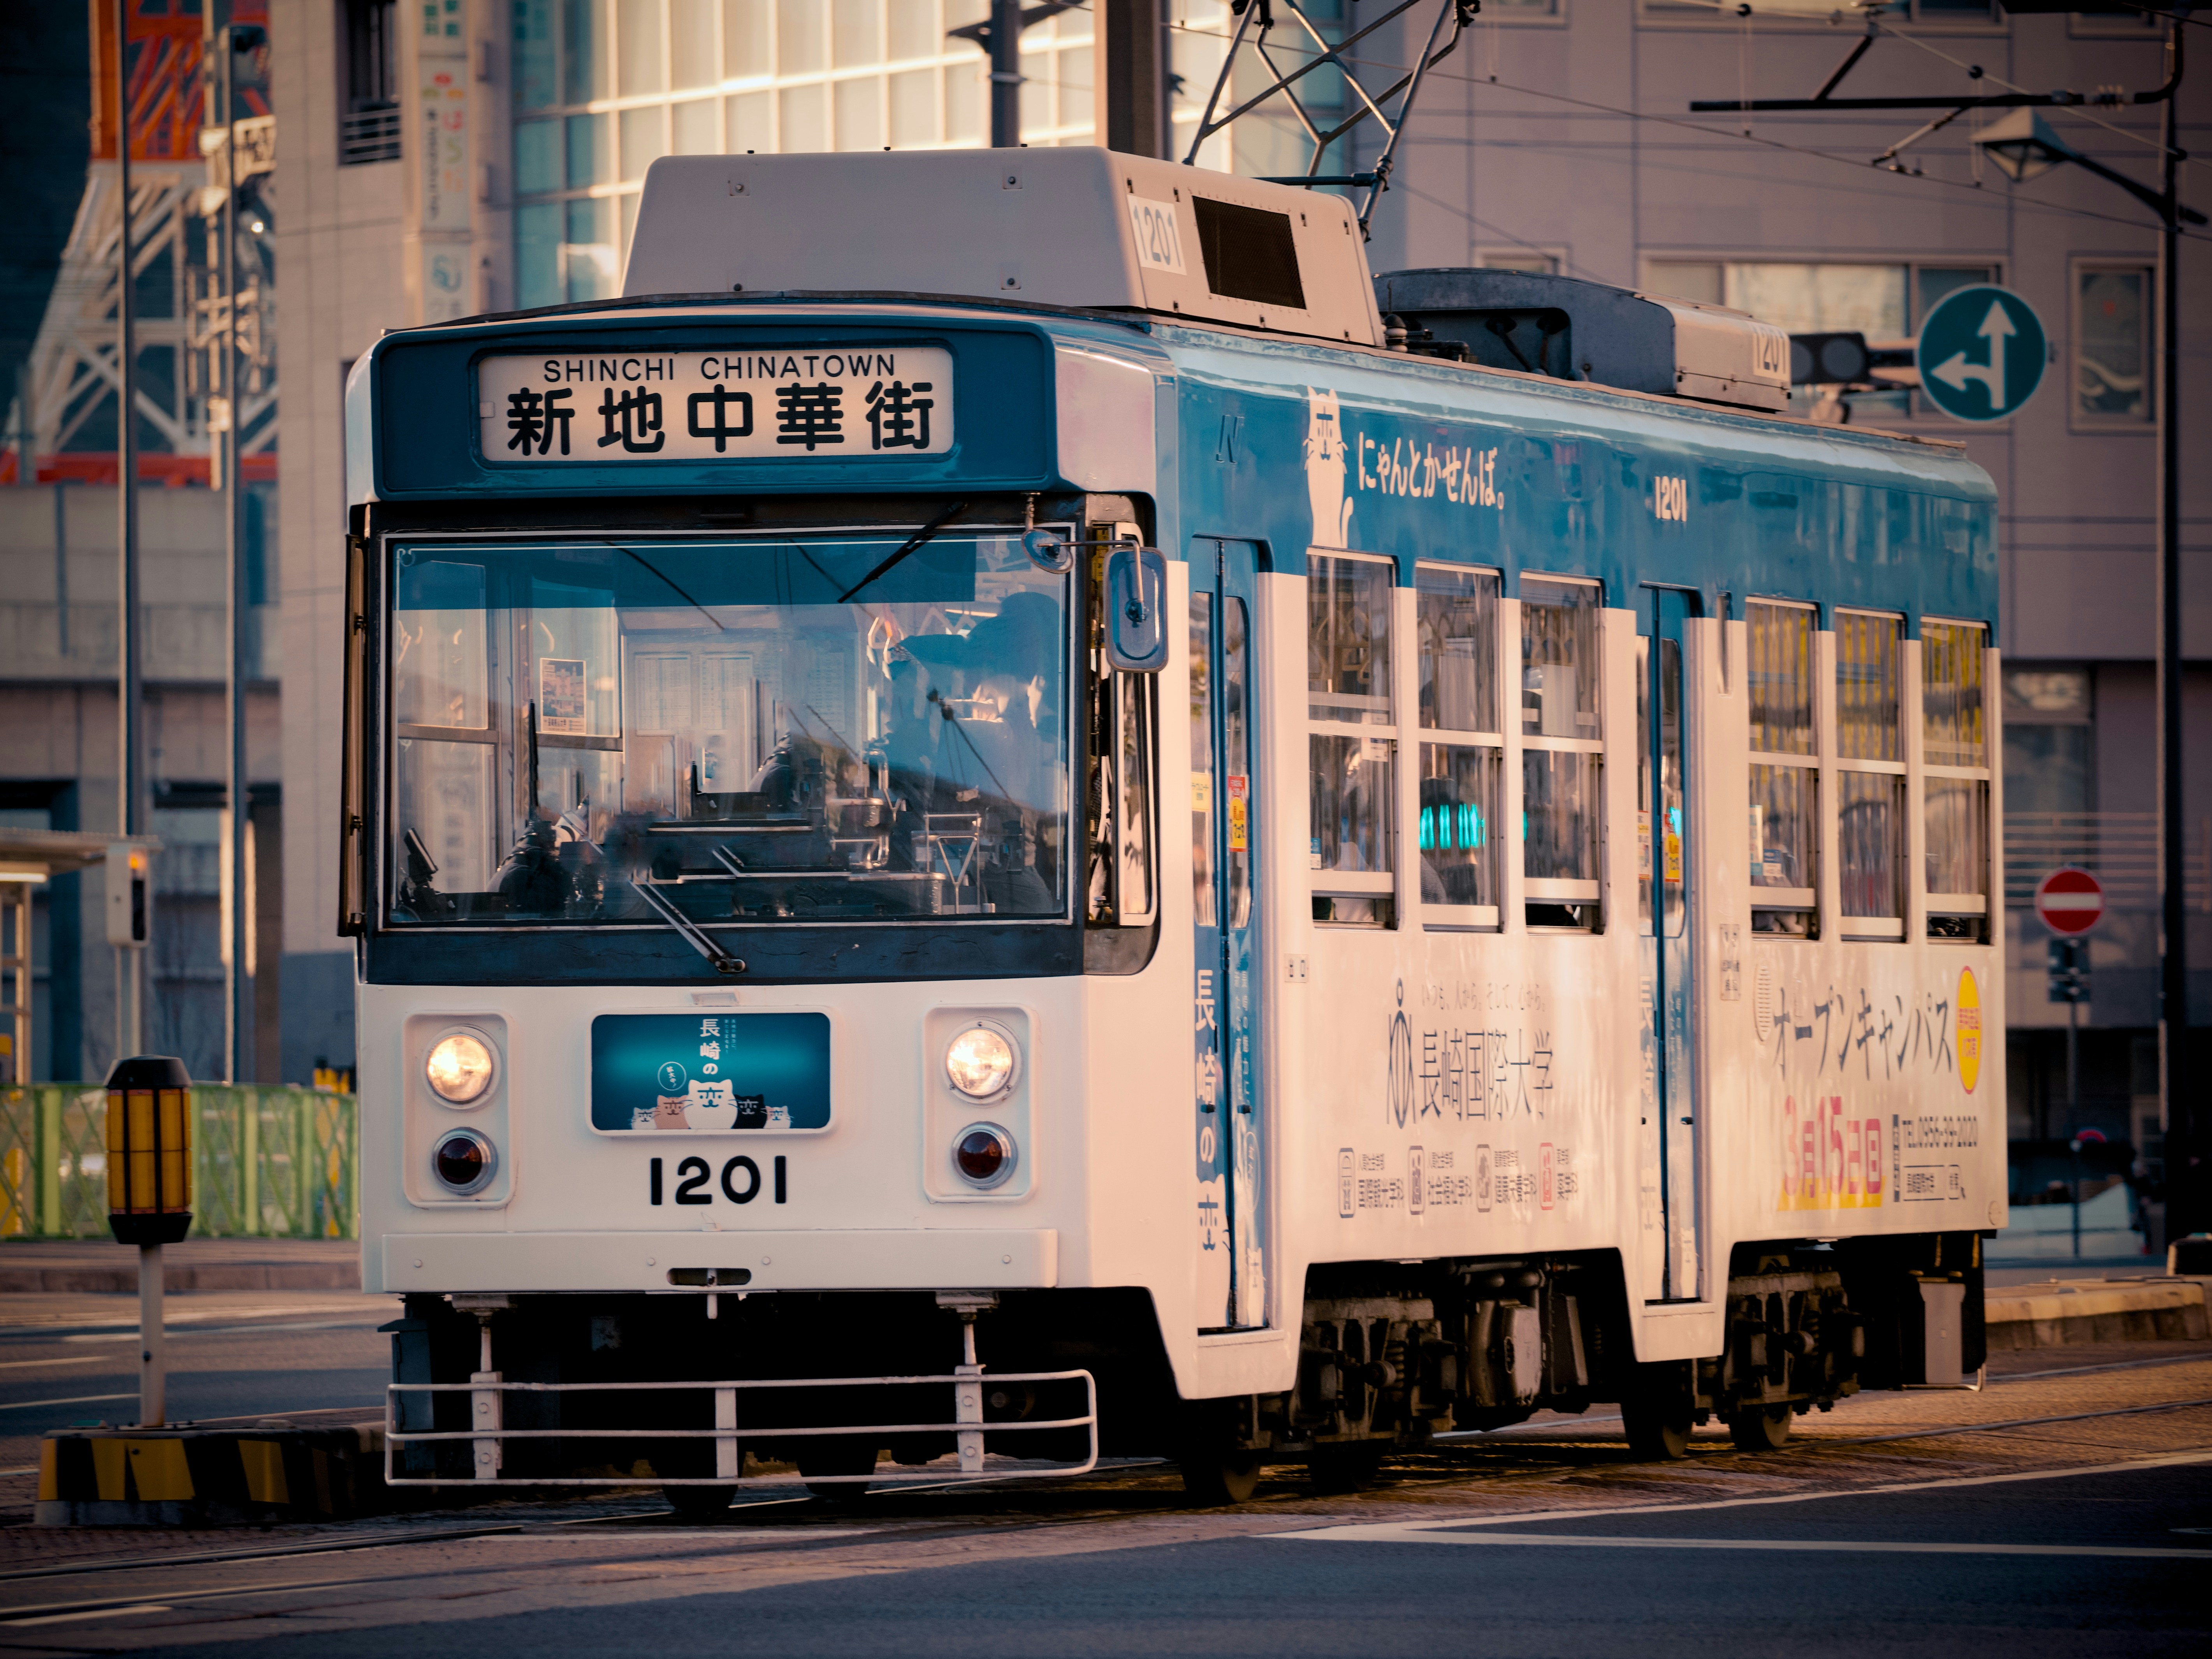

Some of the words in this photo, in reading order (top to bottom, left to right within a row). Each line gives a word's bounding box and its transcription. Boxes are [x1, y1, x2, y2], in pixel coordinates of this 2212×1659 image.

[1133, 205, 1182, 267] 1201
[544, 358, 674, 383] SHINCHI
[702, 354, 895, 380] CHINATOWN
[1753, 326, 1786, 374] 1201
[507, 381, 934, 456] 新地中華街
[1358, 431, 1505, 510] にゃんとかせんば。
[1655, 475, 1688, 522] 1201
[1772, 984, 1952, 1082] オープンキャンパス
[1419, 1027, 1553, 1121] 長崎国際大学
[651, 1155, 787, 1205] 1201
